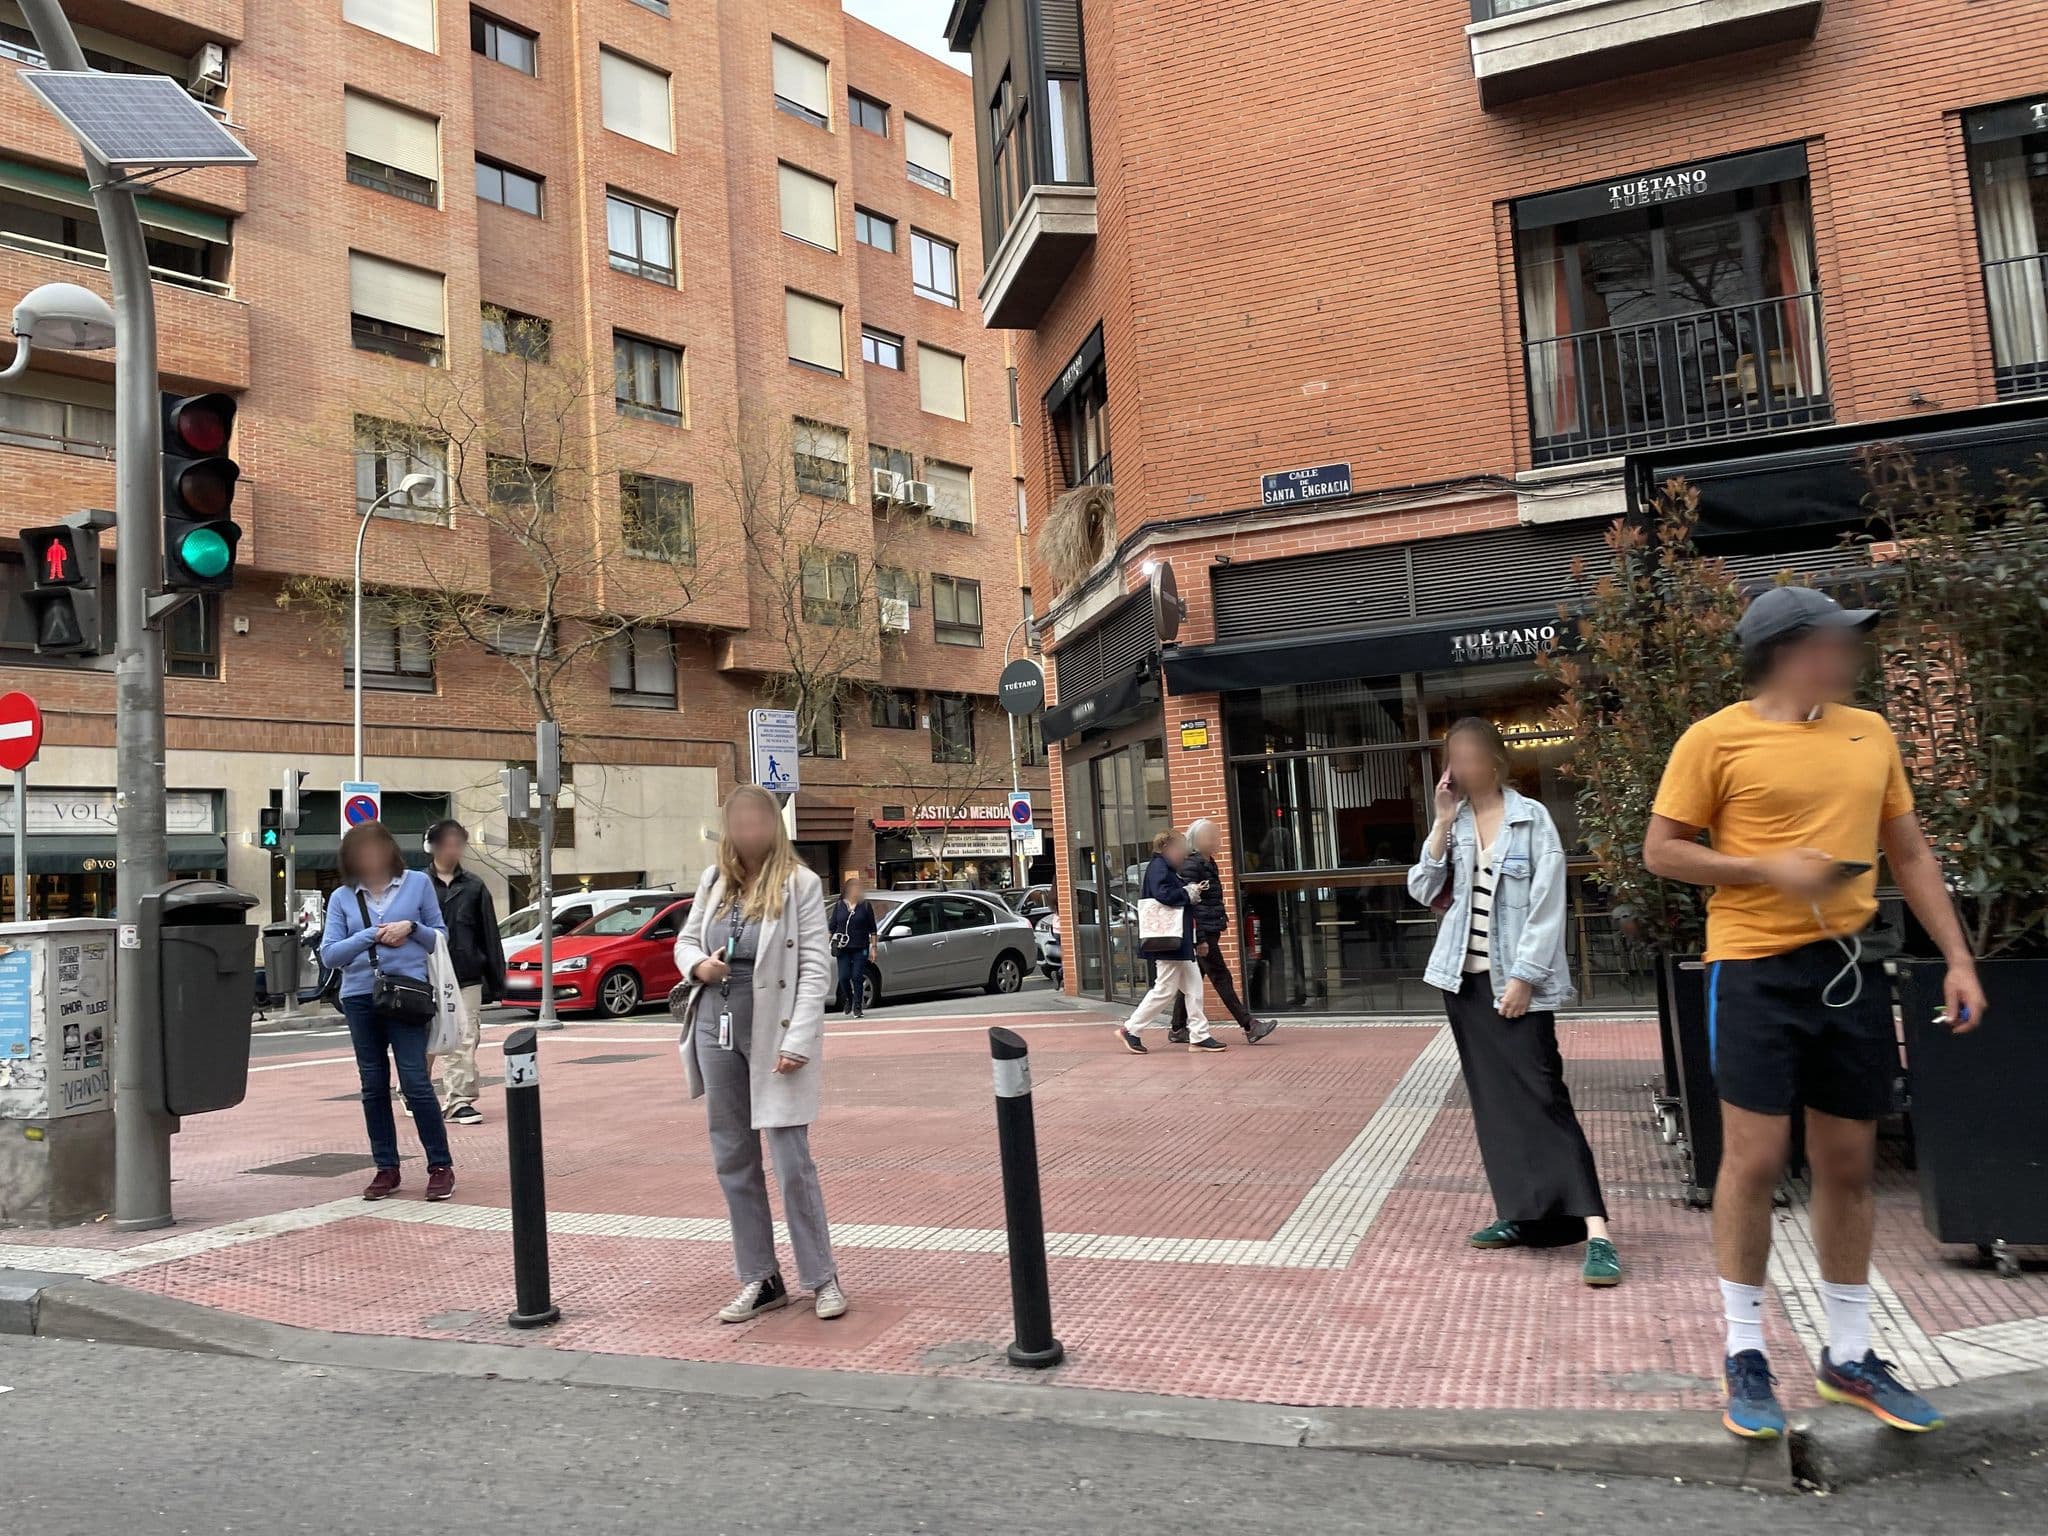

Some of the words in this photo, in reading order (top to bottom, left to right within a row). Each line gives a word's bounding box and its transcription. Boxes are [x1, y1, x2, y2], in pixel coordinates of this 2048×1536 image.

[1608, 169, 1706, 198] TUÉTANO
[1288, 469, 1318, 480] CALLE
[1265, 487, 1295, 503] SANTA
[1301, 479, 1349, 498] ENGRACIA
[1450, 625, 1555, 649] TUÉTANO
[1004, 679, 1037, 691] TUÉTANO
[970, 802, 1011, 820] MENDÍA
